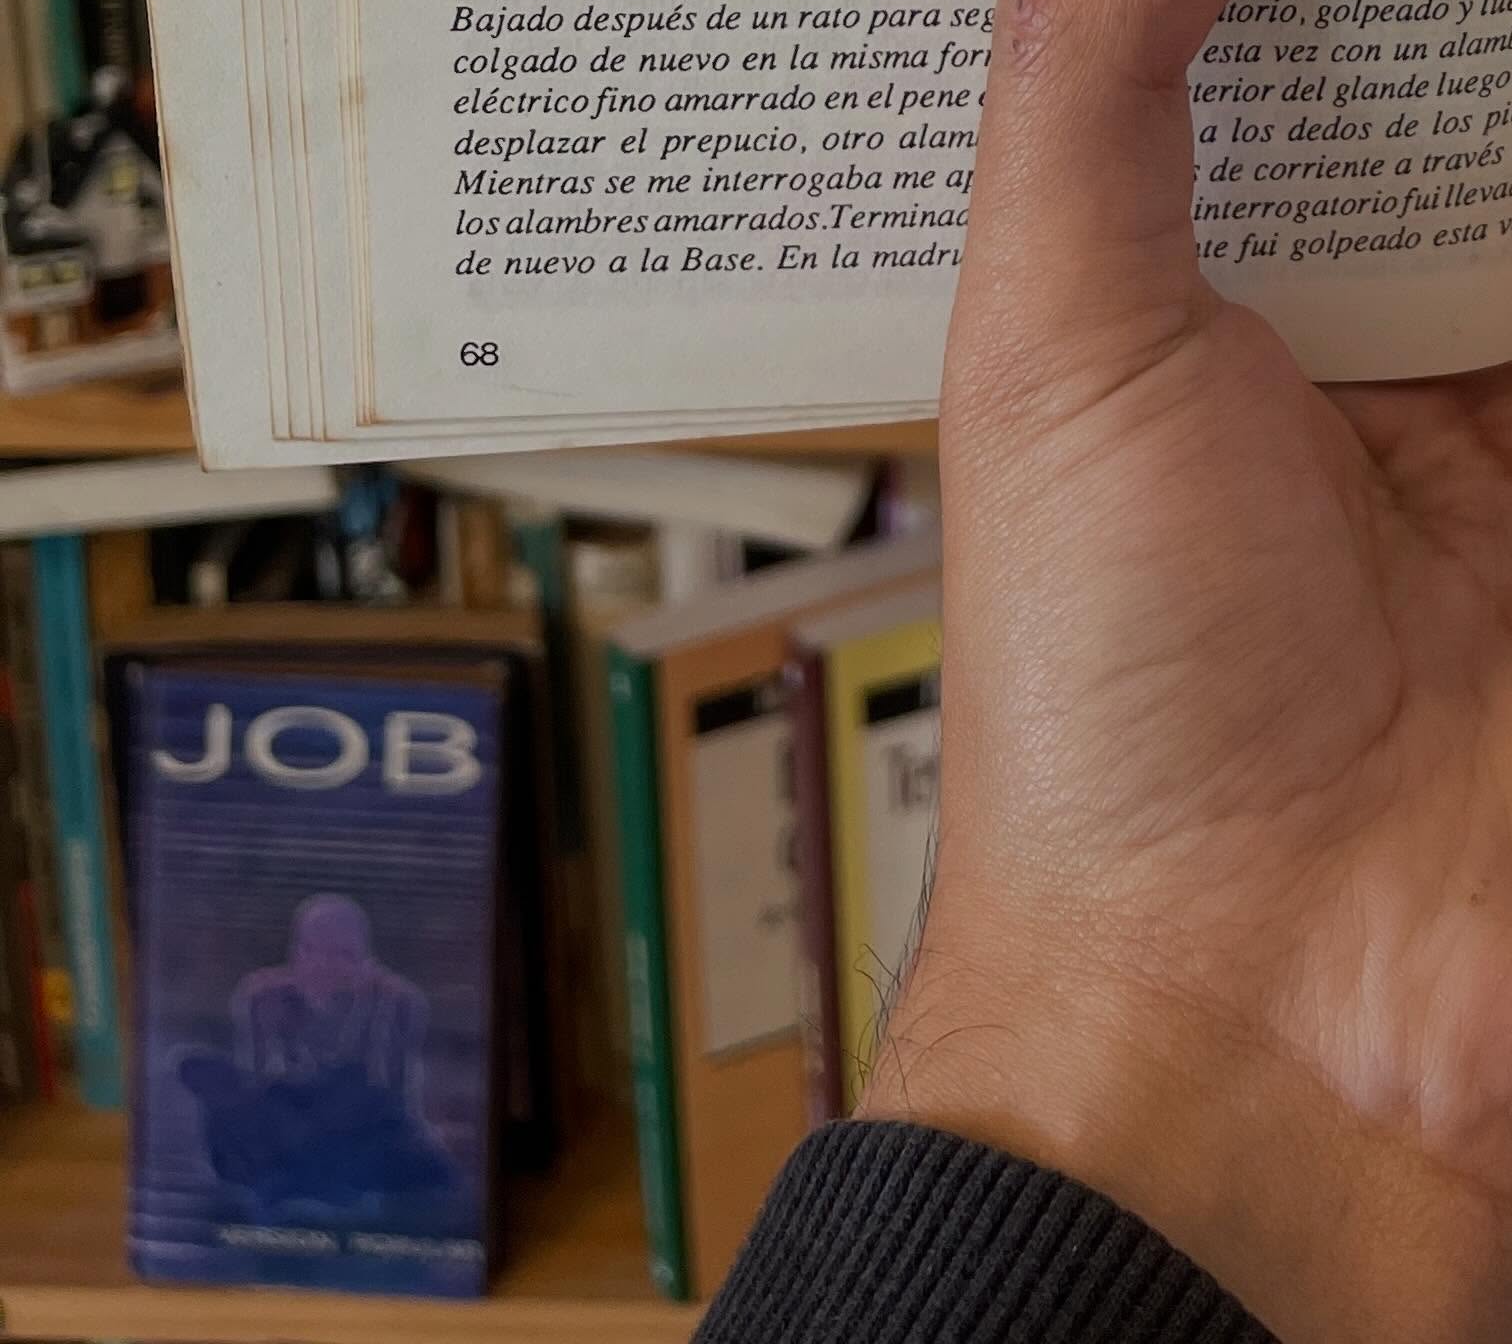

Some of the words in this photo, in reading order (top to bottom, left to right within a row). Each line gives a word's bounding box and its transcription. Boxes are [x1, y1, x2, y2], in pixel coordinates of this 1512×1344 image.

[456, 250, 491, 275] de
[504, 256, 595, 274] nuevo
[609, 256, 627, 273] a
[641, 248, 669, 272] la
[681, 247, 763, 271] Base.
[777, 245, 817, 269] En
[832, 244, 859, 269] la
[1234, 233, 1279, 264] fui
[1290, 226, 1421, 261] golpeado
[1433, 224, 1488, 246] esta
[460, 342, 499, 366] 68
[152, 701, 482, 797] JOB
